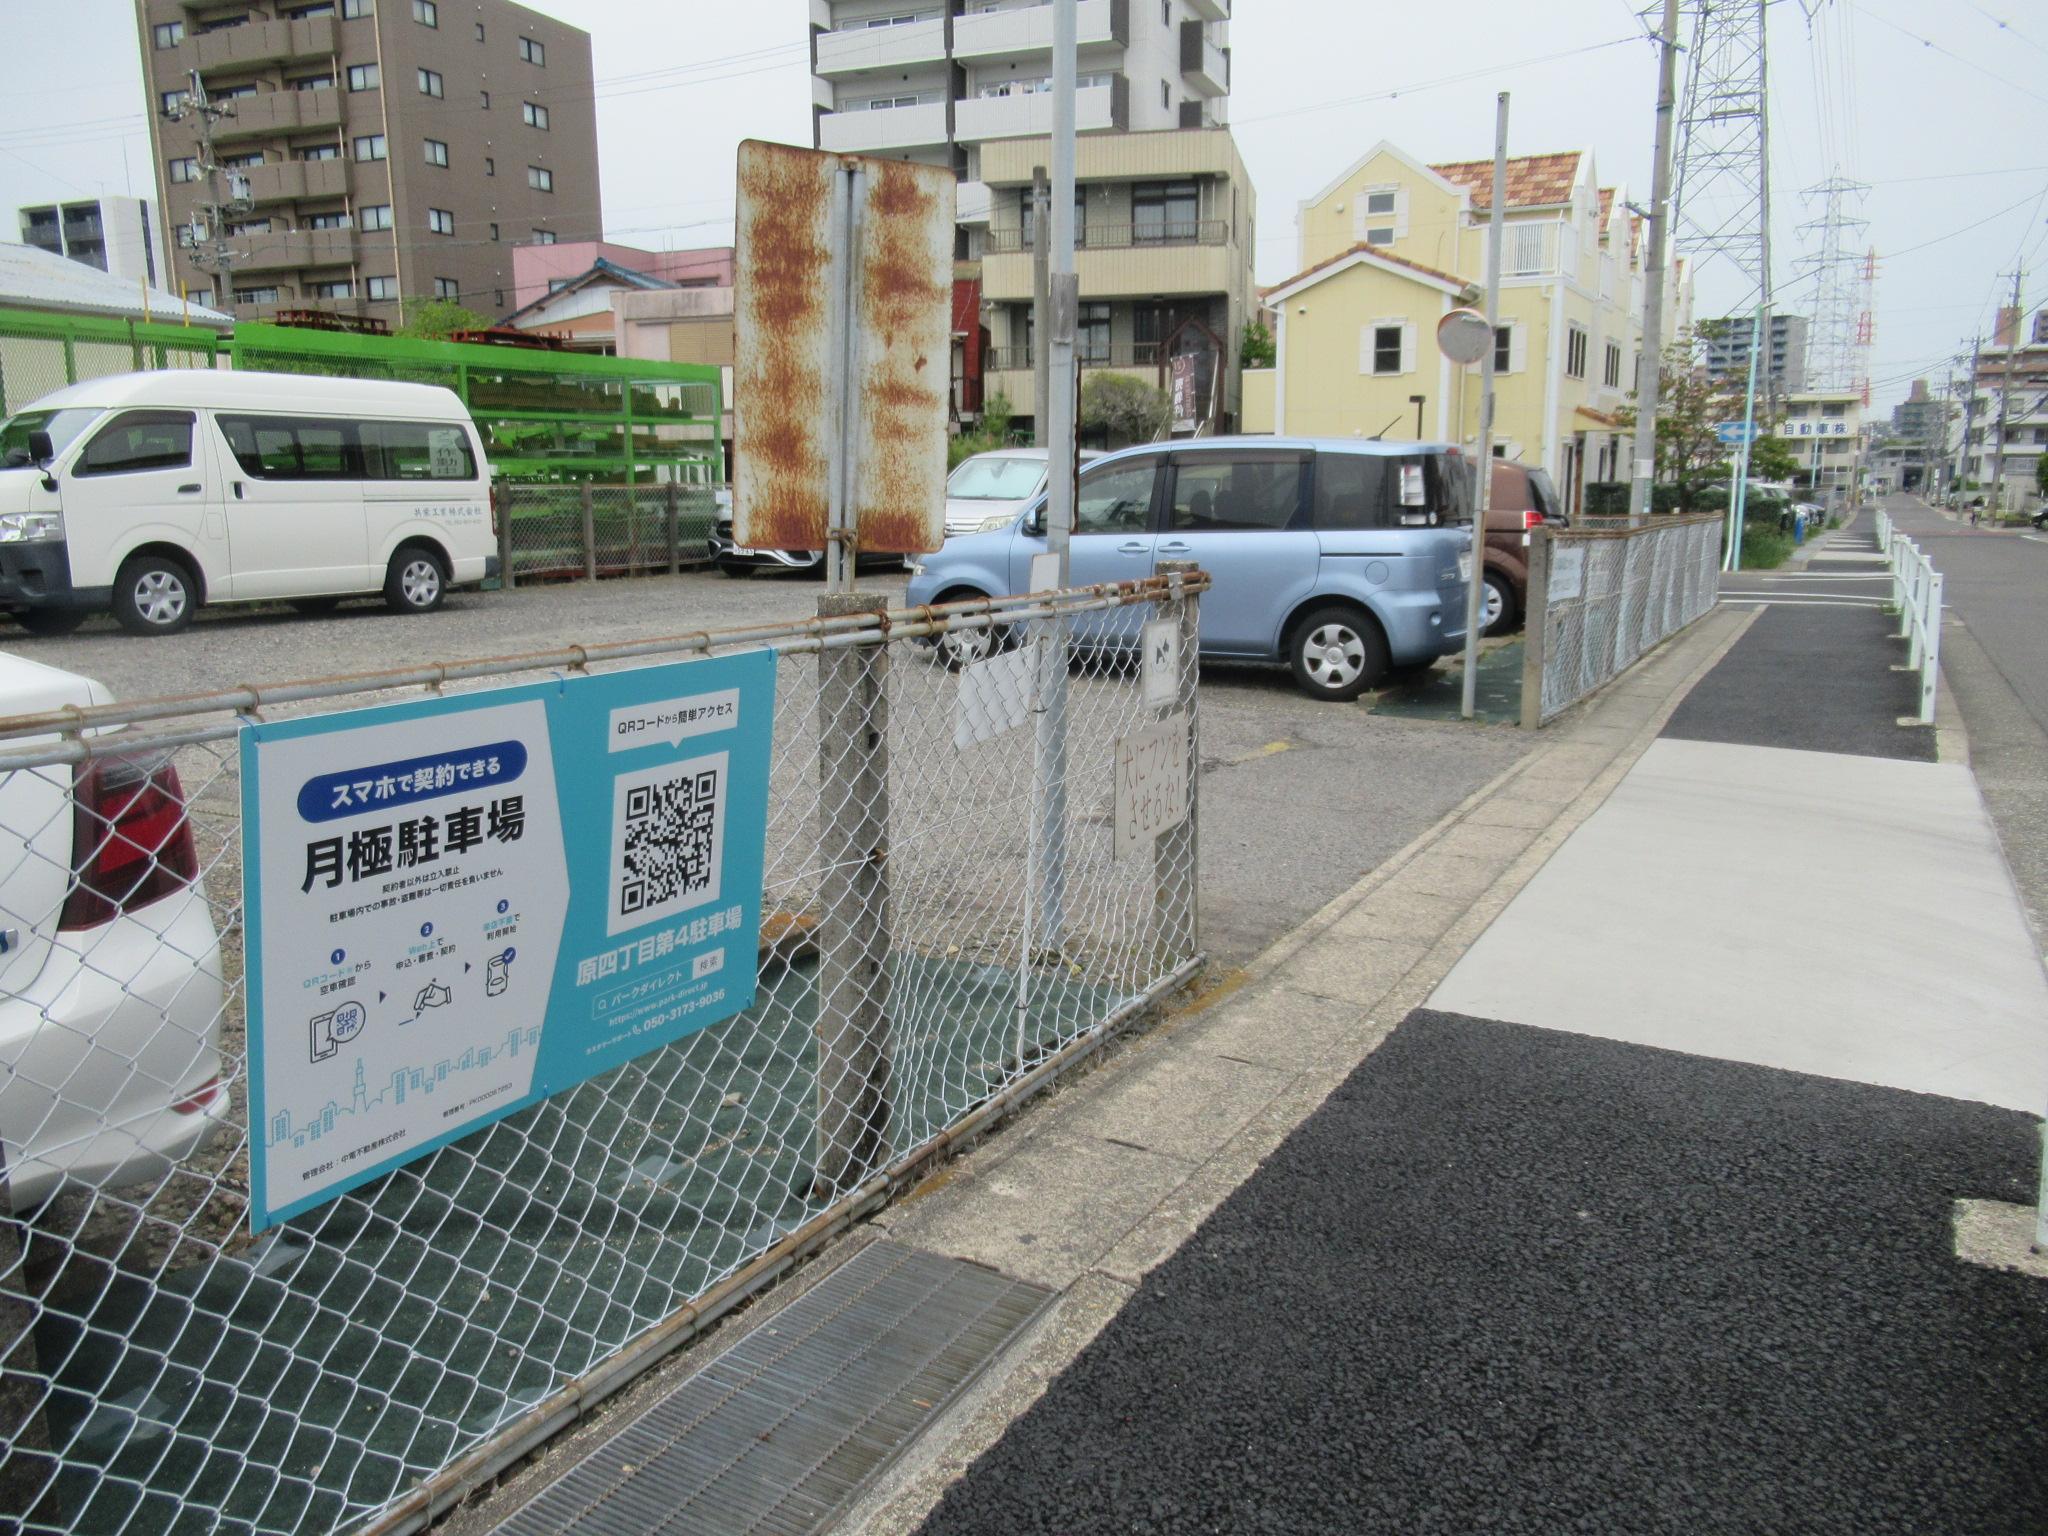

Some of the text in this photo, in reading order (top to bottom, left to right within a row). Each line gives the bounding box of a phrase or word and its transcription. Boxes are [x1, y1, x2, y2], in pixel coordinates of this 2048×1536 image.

[617, 701, 733, 735] QRコードから簡単アクセス
[331, 756, 501, 809] スマホで契約できる
[300, 795, 526, 895] 月極駐車場
[382, 866, 460, 893] 契約者以外は立入禁止
[576, 904, 743, 987] 原四丁目第4駐車場
[699, 955, 719, 972] 検索
[611, 970, 683, 1007] パークダイレクト
